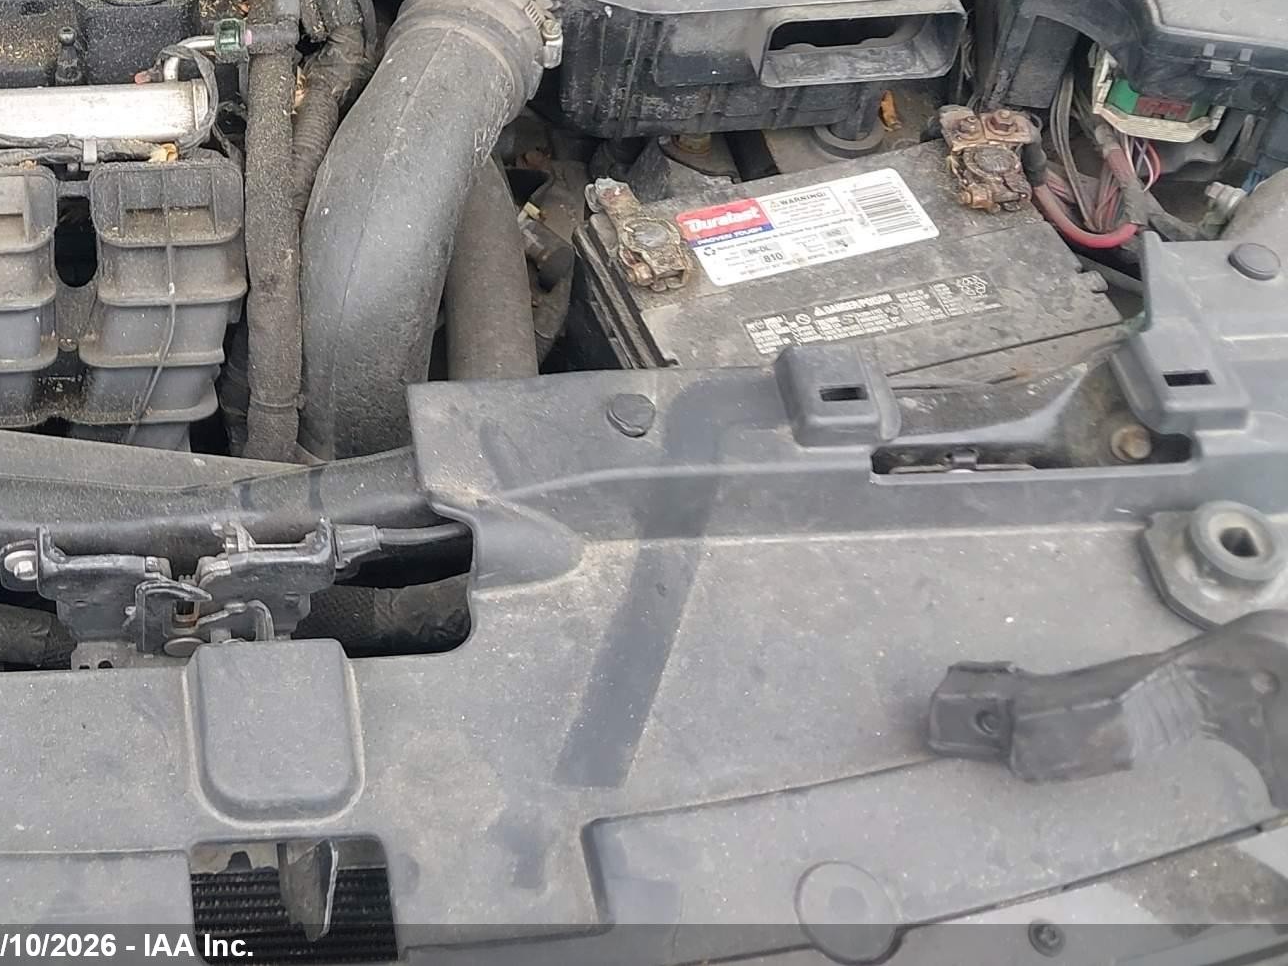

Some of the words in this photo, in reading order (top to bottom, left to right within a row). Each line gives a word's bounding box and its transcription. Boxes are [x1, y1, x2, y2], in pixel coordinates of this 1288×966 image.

[683, 206, 761, 233] Duralast
[696, 233, 733, 246] PROVEN
[734, 226, 763, 238] TOUGH
[762, 251, 784, 264] 810
